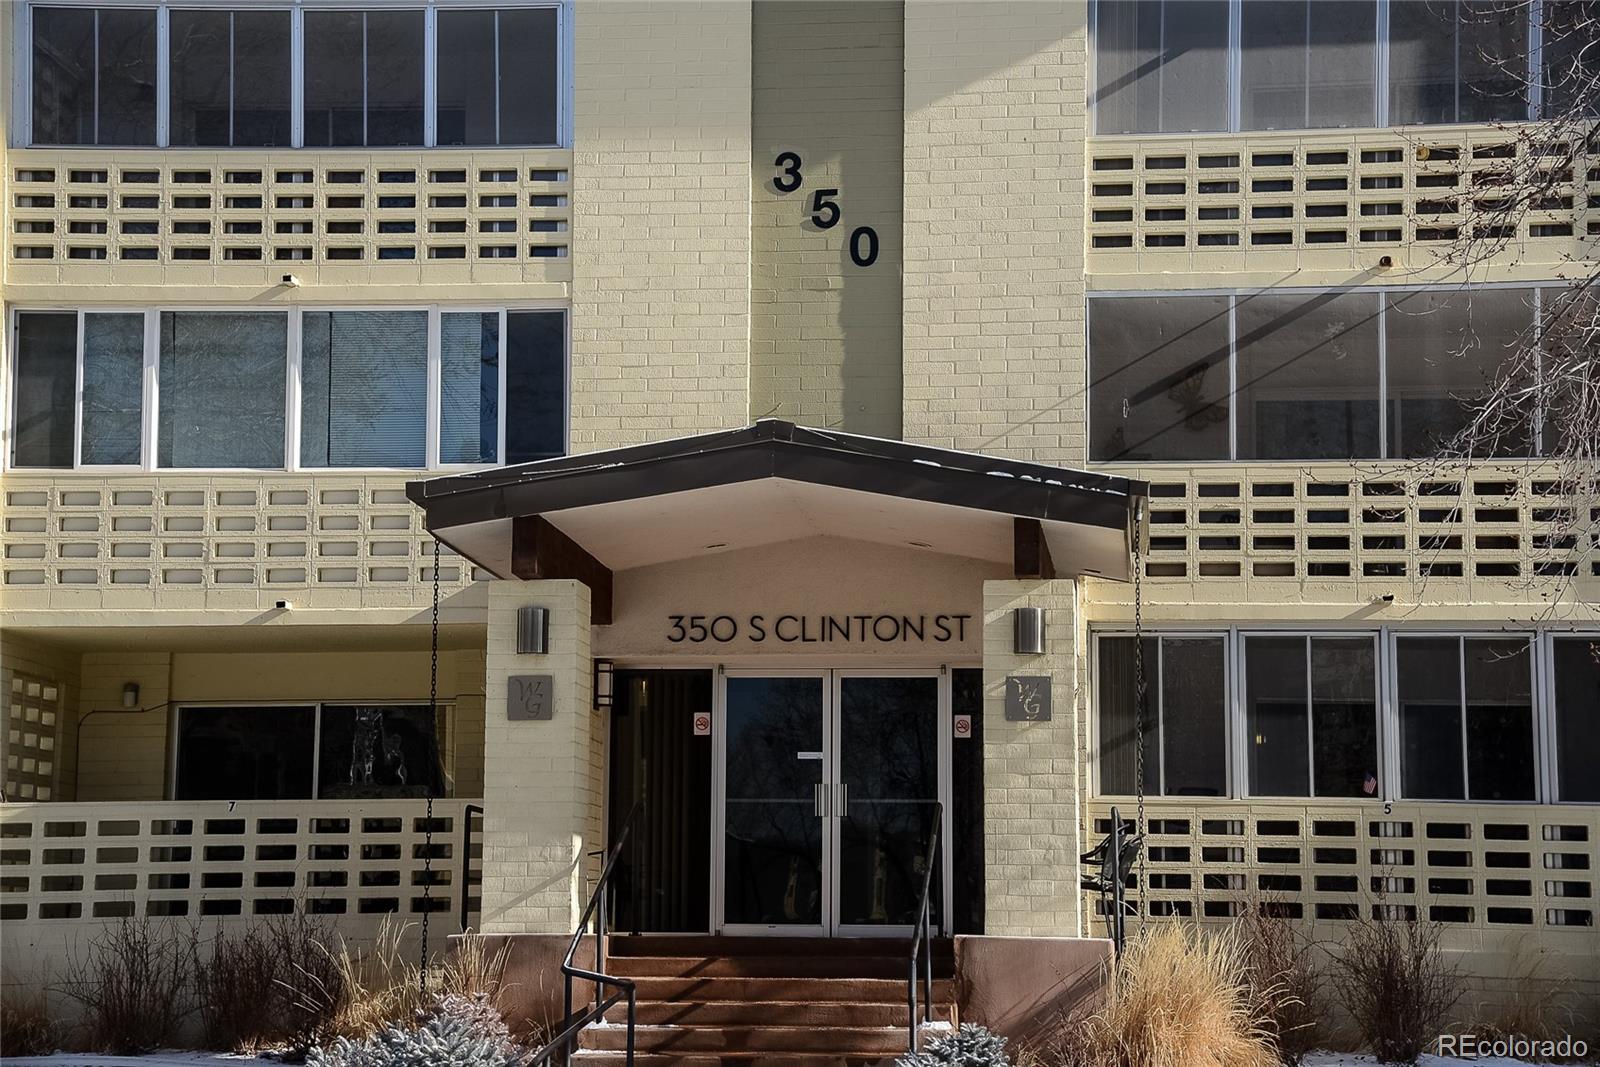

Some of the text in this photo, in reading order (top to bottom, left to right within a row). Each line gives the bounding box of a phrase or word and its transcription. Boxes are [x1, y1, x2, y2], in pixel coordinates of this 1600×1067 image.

[773, 152, 879, 267] 350
[667, 615, 972, 643] 350 S CLINTON ST
[228, 801, 236, 812] 7
[1384, 803, 1392, 815] 5
